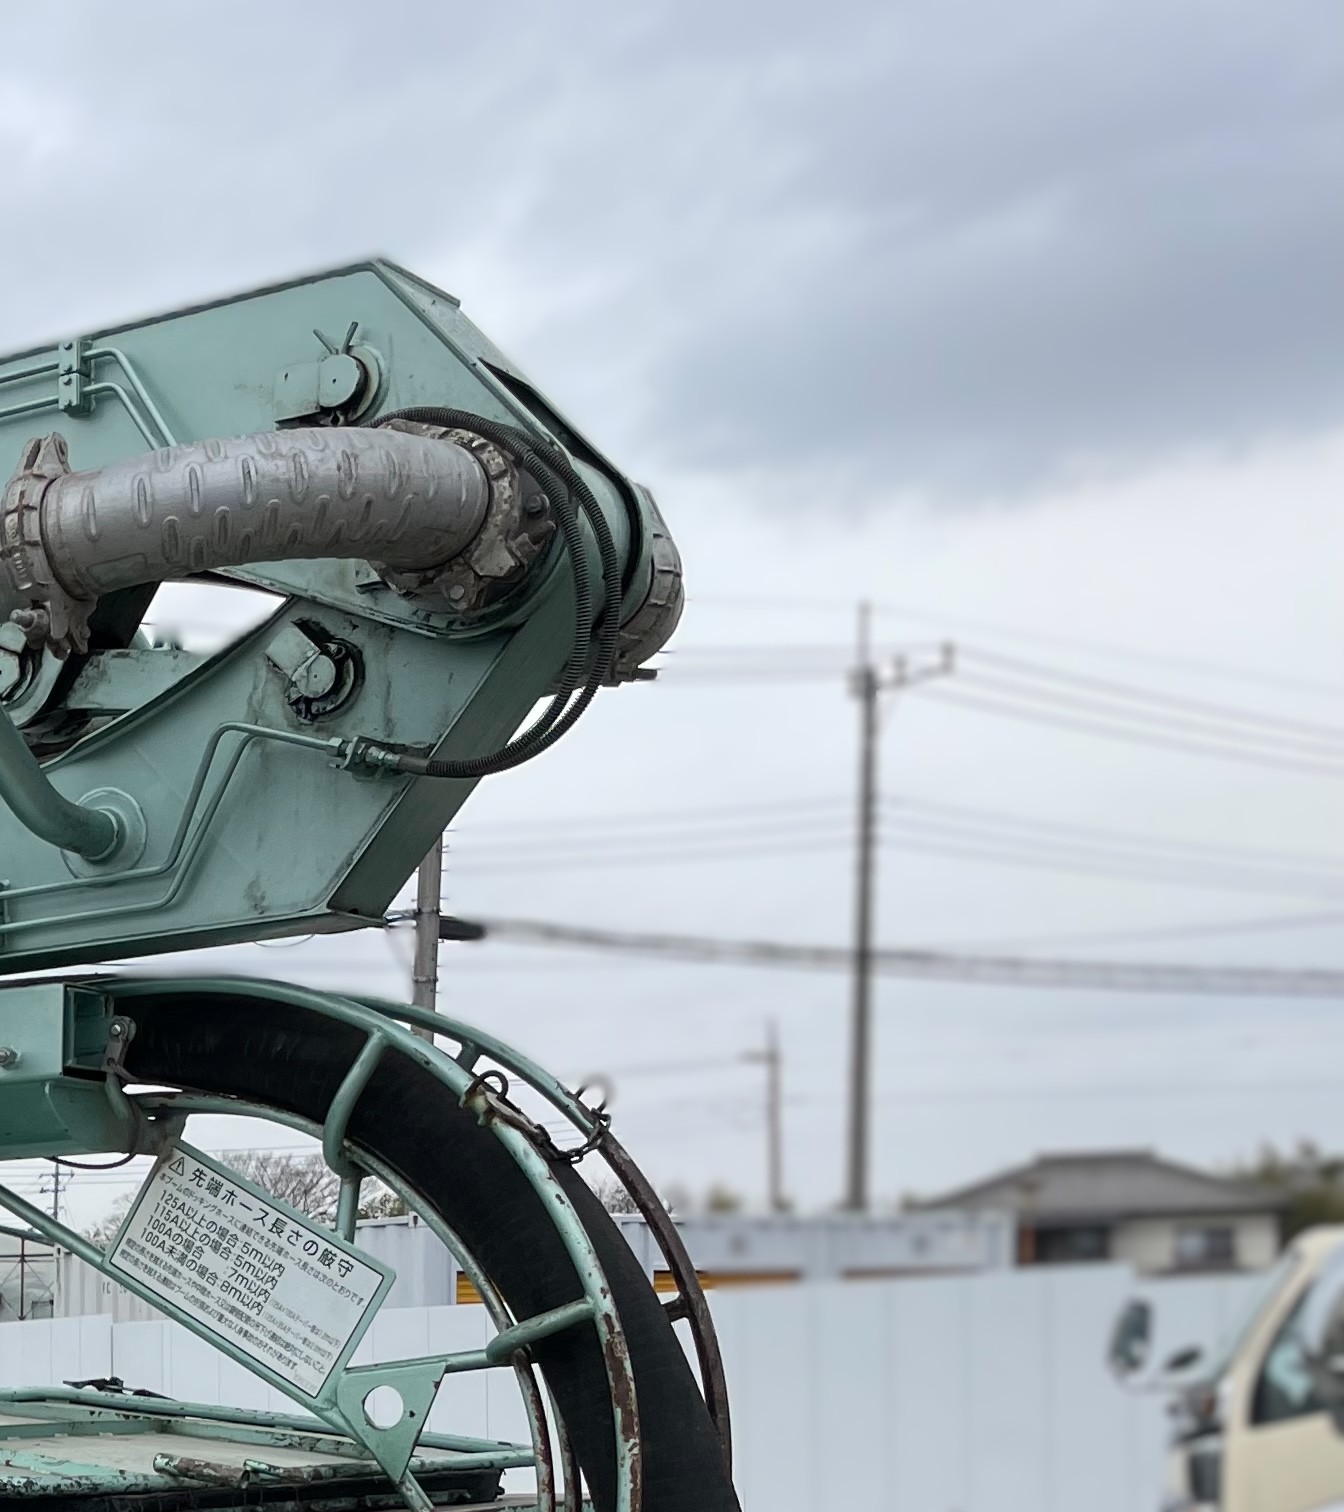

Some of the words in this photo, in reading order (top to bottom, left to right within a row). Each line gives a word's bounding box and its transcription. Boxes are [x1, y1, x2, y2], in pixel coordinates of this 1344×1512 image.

[187, 1165, 355, 1280] 先端ホース長さの厳守
